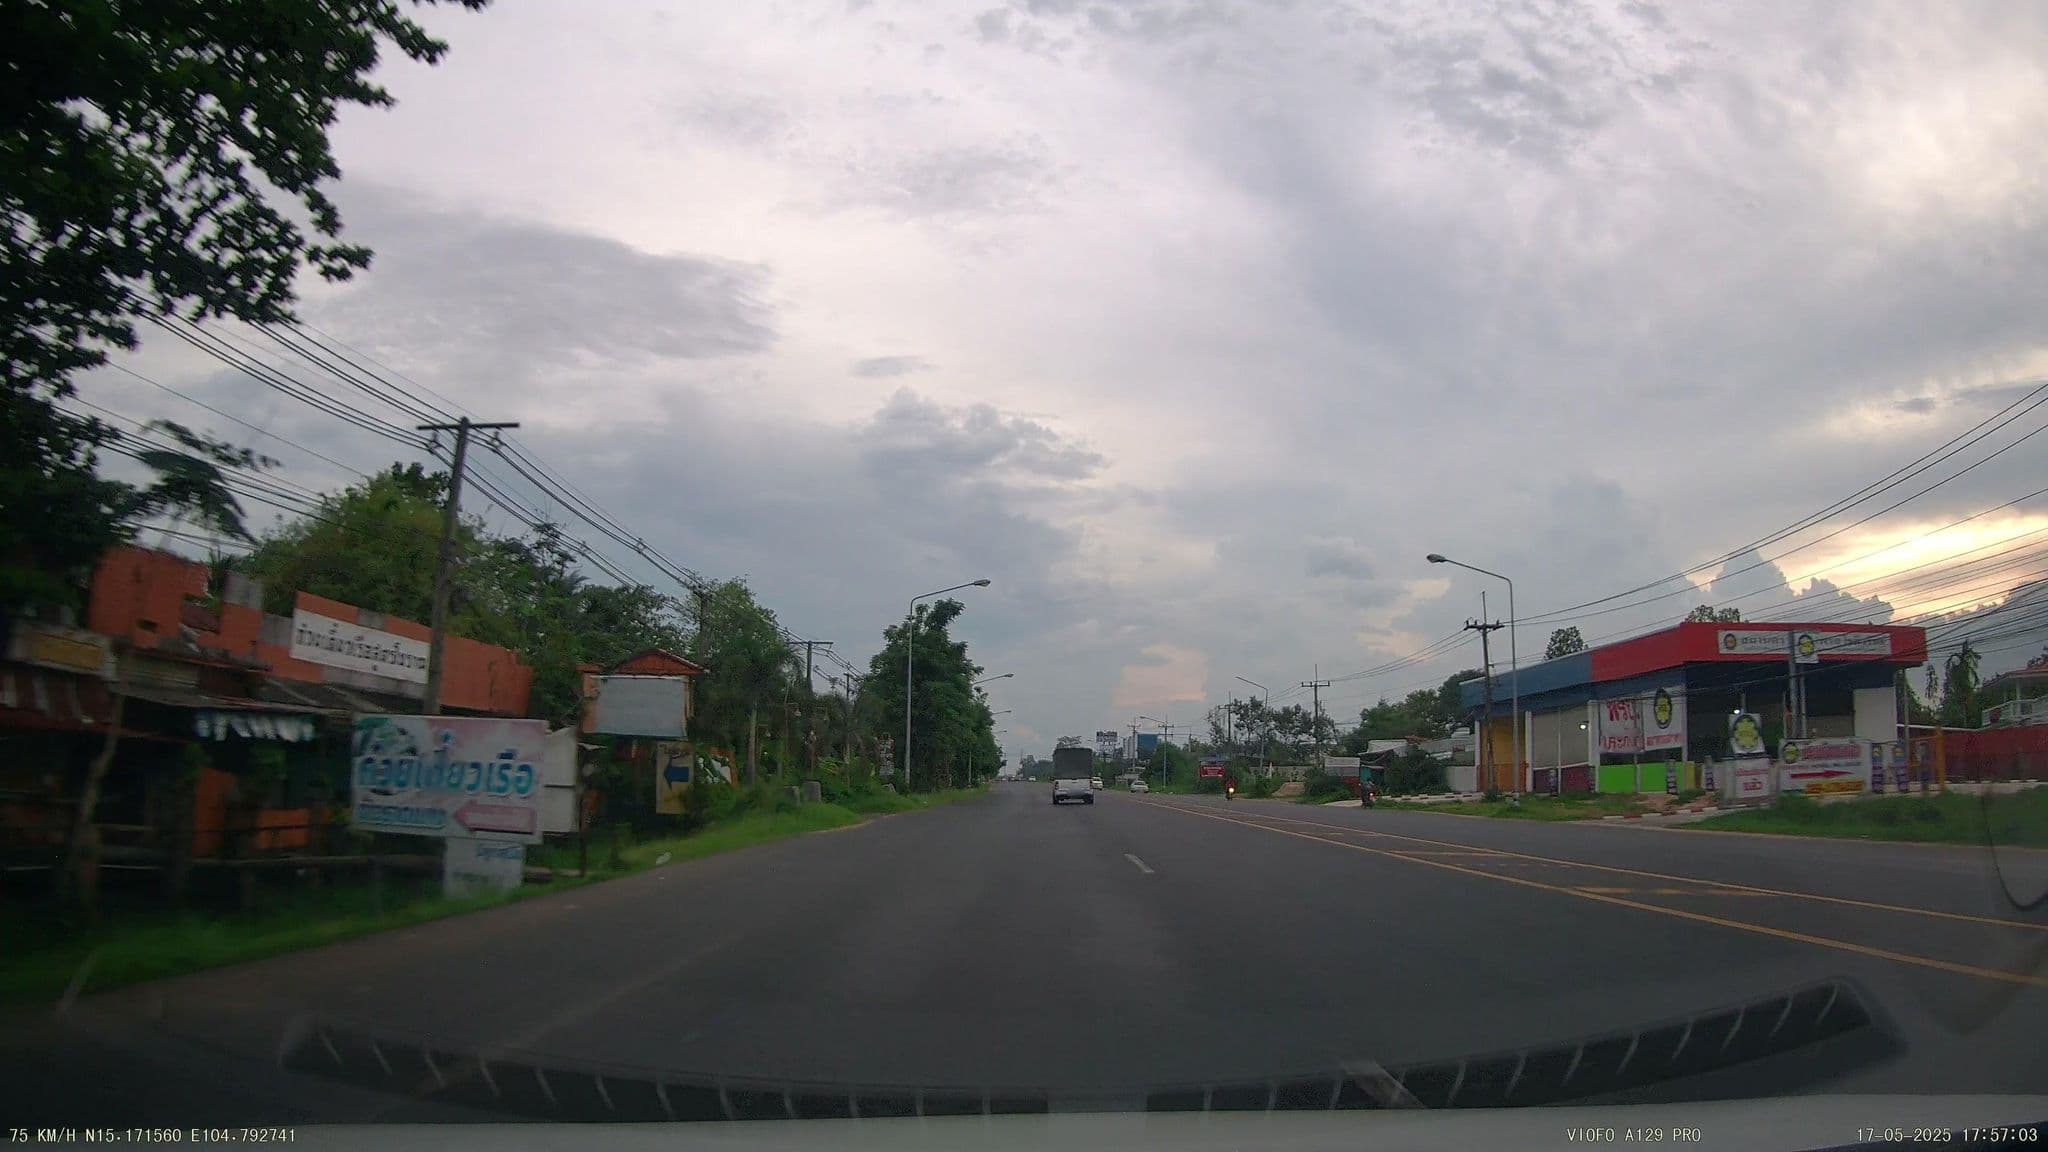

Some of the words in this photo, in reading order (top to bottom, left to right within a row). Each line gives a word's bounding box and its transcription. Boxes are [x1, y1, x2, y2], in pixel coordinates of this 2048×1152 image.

[357, 729, 537, 797] ก๋วยเตี๋ยวเรือ
